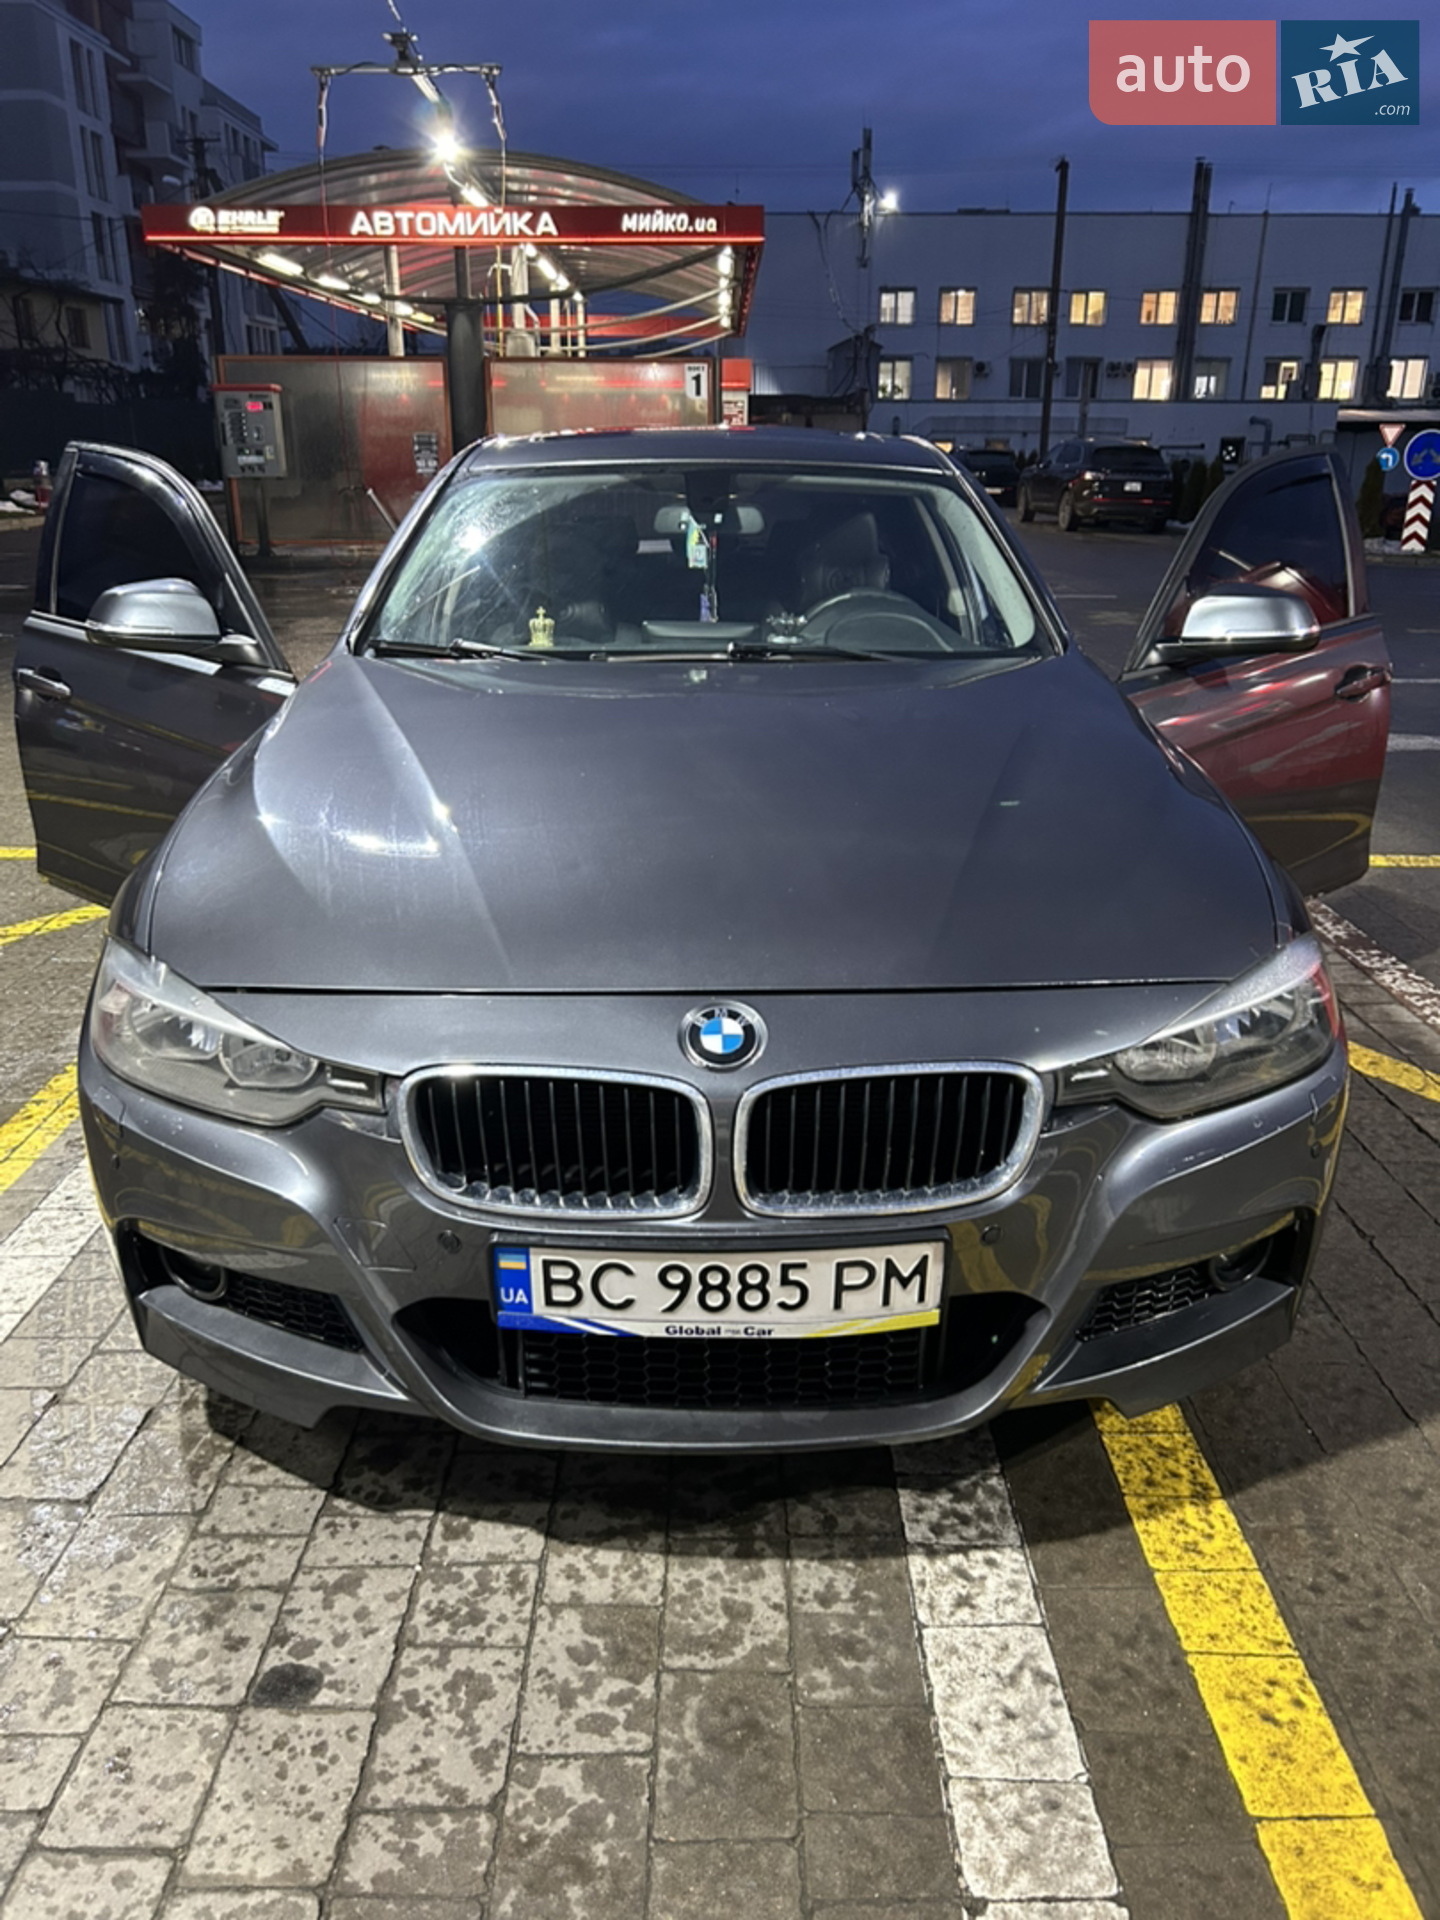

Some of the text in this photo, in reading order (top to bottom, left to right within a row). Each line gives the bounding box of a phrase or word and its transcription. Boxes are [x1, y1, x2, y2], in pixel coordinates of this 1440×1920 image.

[351, 204, 559, 236] АВТОМИЙКА
[621, 209, 718, 233] МИЙКО.ua
[692, 373, 701, 397] 1
[541, 1254, 929, 1313] BC 9885 PM
[500, 1287, 529, 1305] UA
[665, 1325, 721, 1336] Global
[744, 1326, 774, 1336] Car
